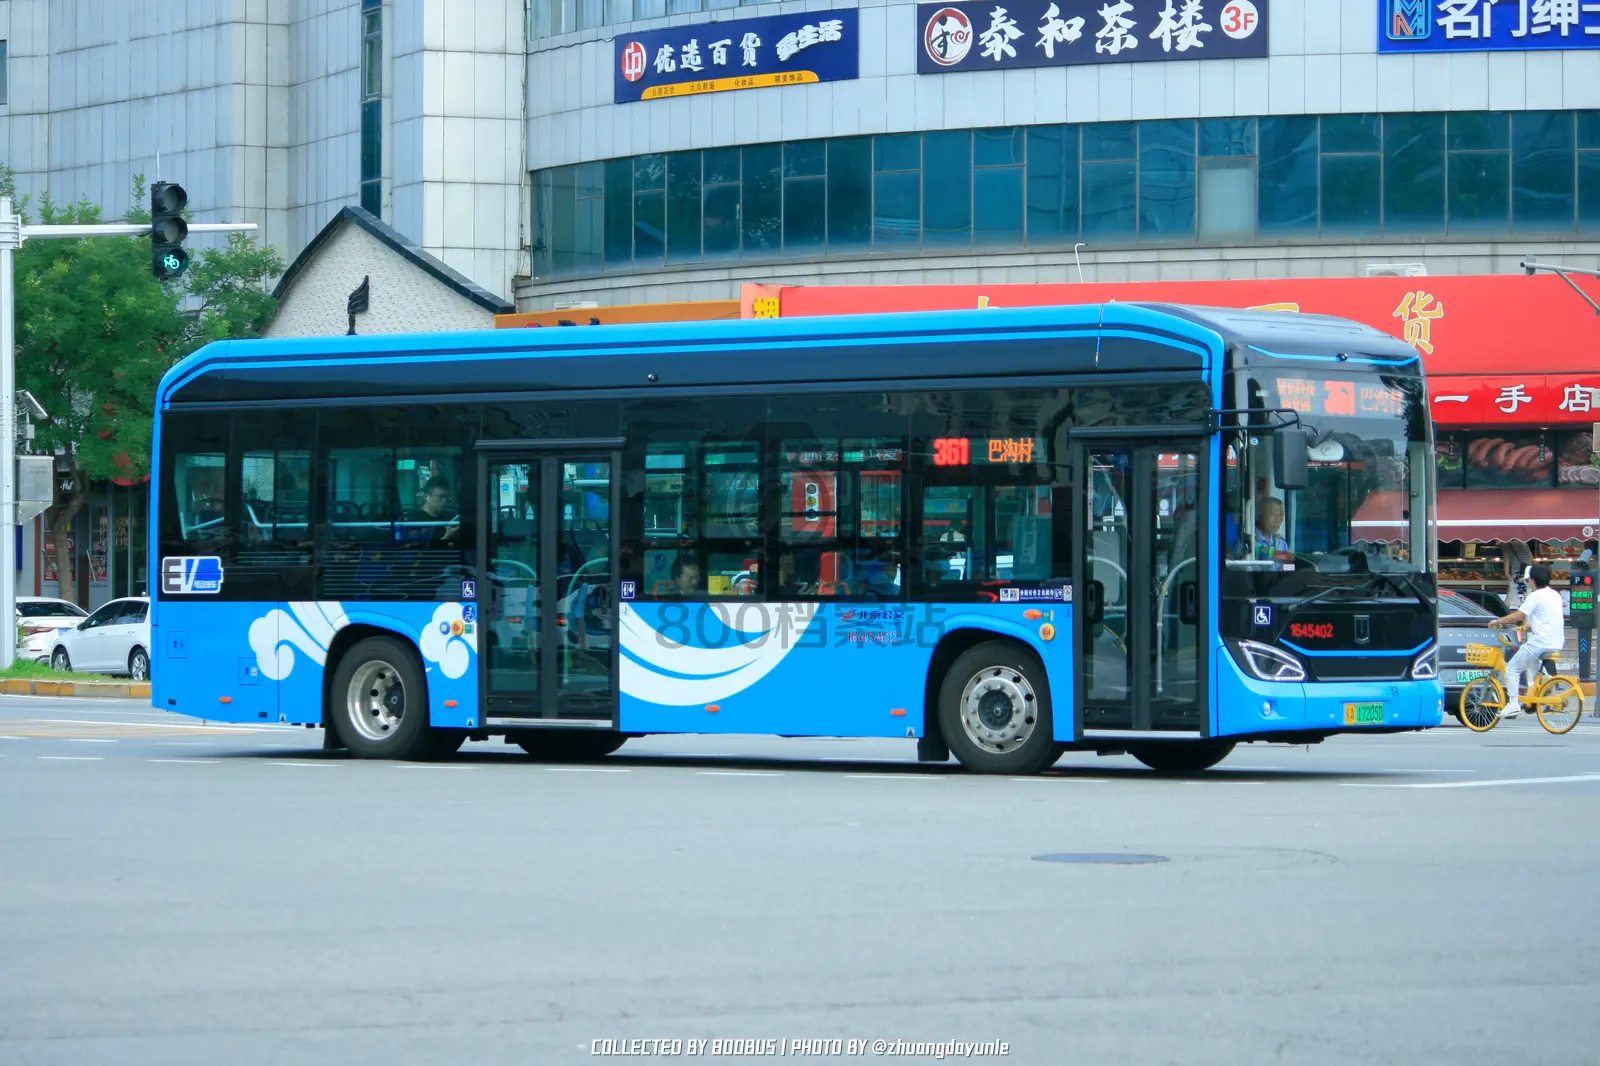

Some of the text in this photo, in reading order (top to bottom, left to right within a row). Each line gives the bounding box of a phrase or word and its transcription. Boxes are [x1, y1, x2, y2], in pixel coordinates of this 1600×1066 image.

[979, 0, 1213, 61] 泰和茶楼
[1223, 6, 1255, 33] 3F
[653, 32, 761, 73] 优选百货
[1434, 384, 1596, 413] 一手店
[933, 438, 969, 465] 361
[988, 437, 1034, 463] 巴沟村
[858, 610, 905, 620] 北京公交
[846, 630, 899, 644] 1645402
[1289, 623, 1334, 638] 1645402
